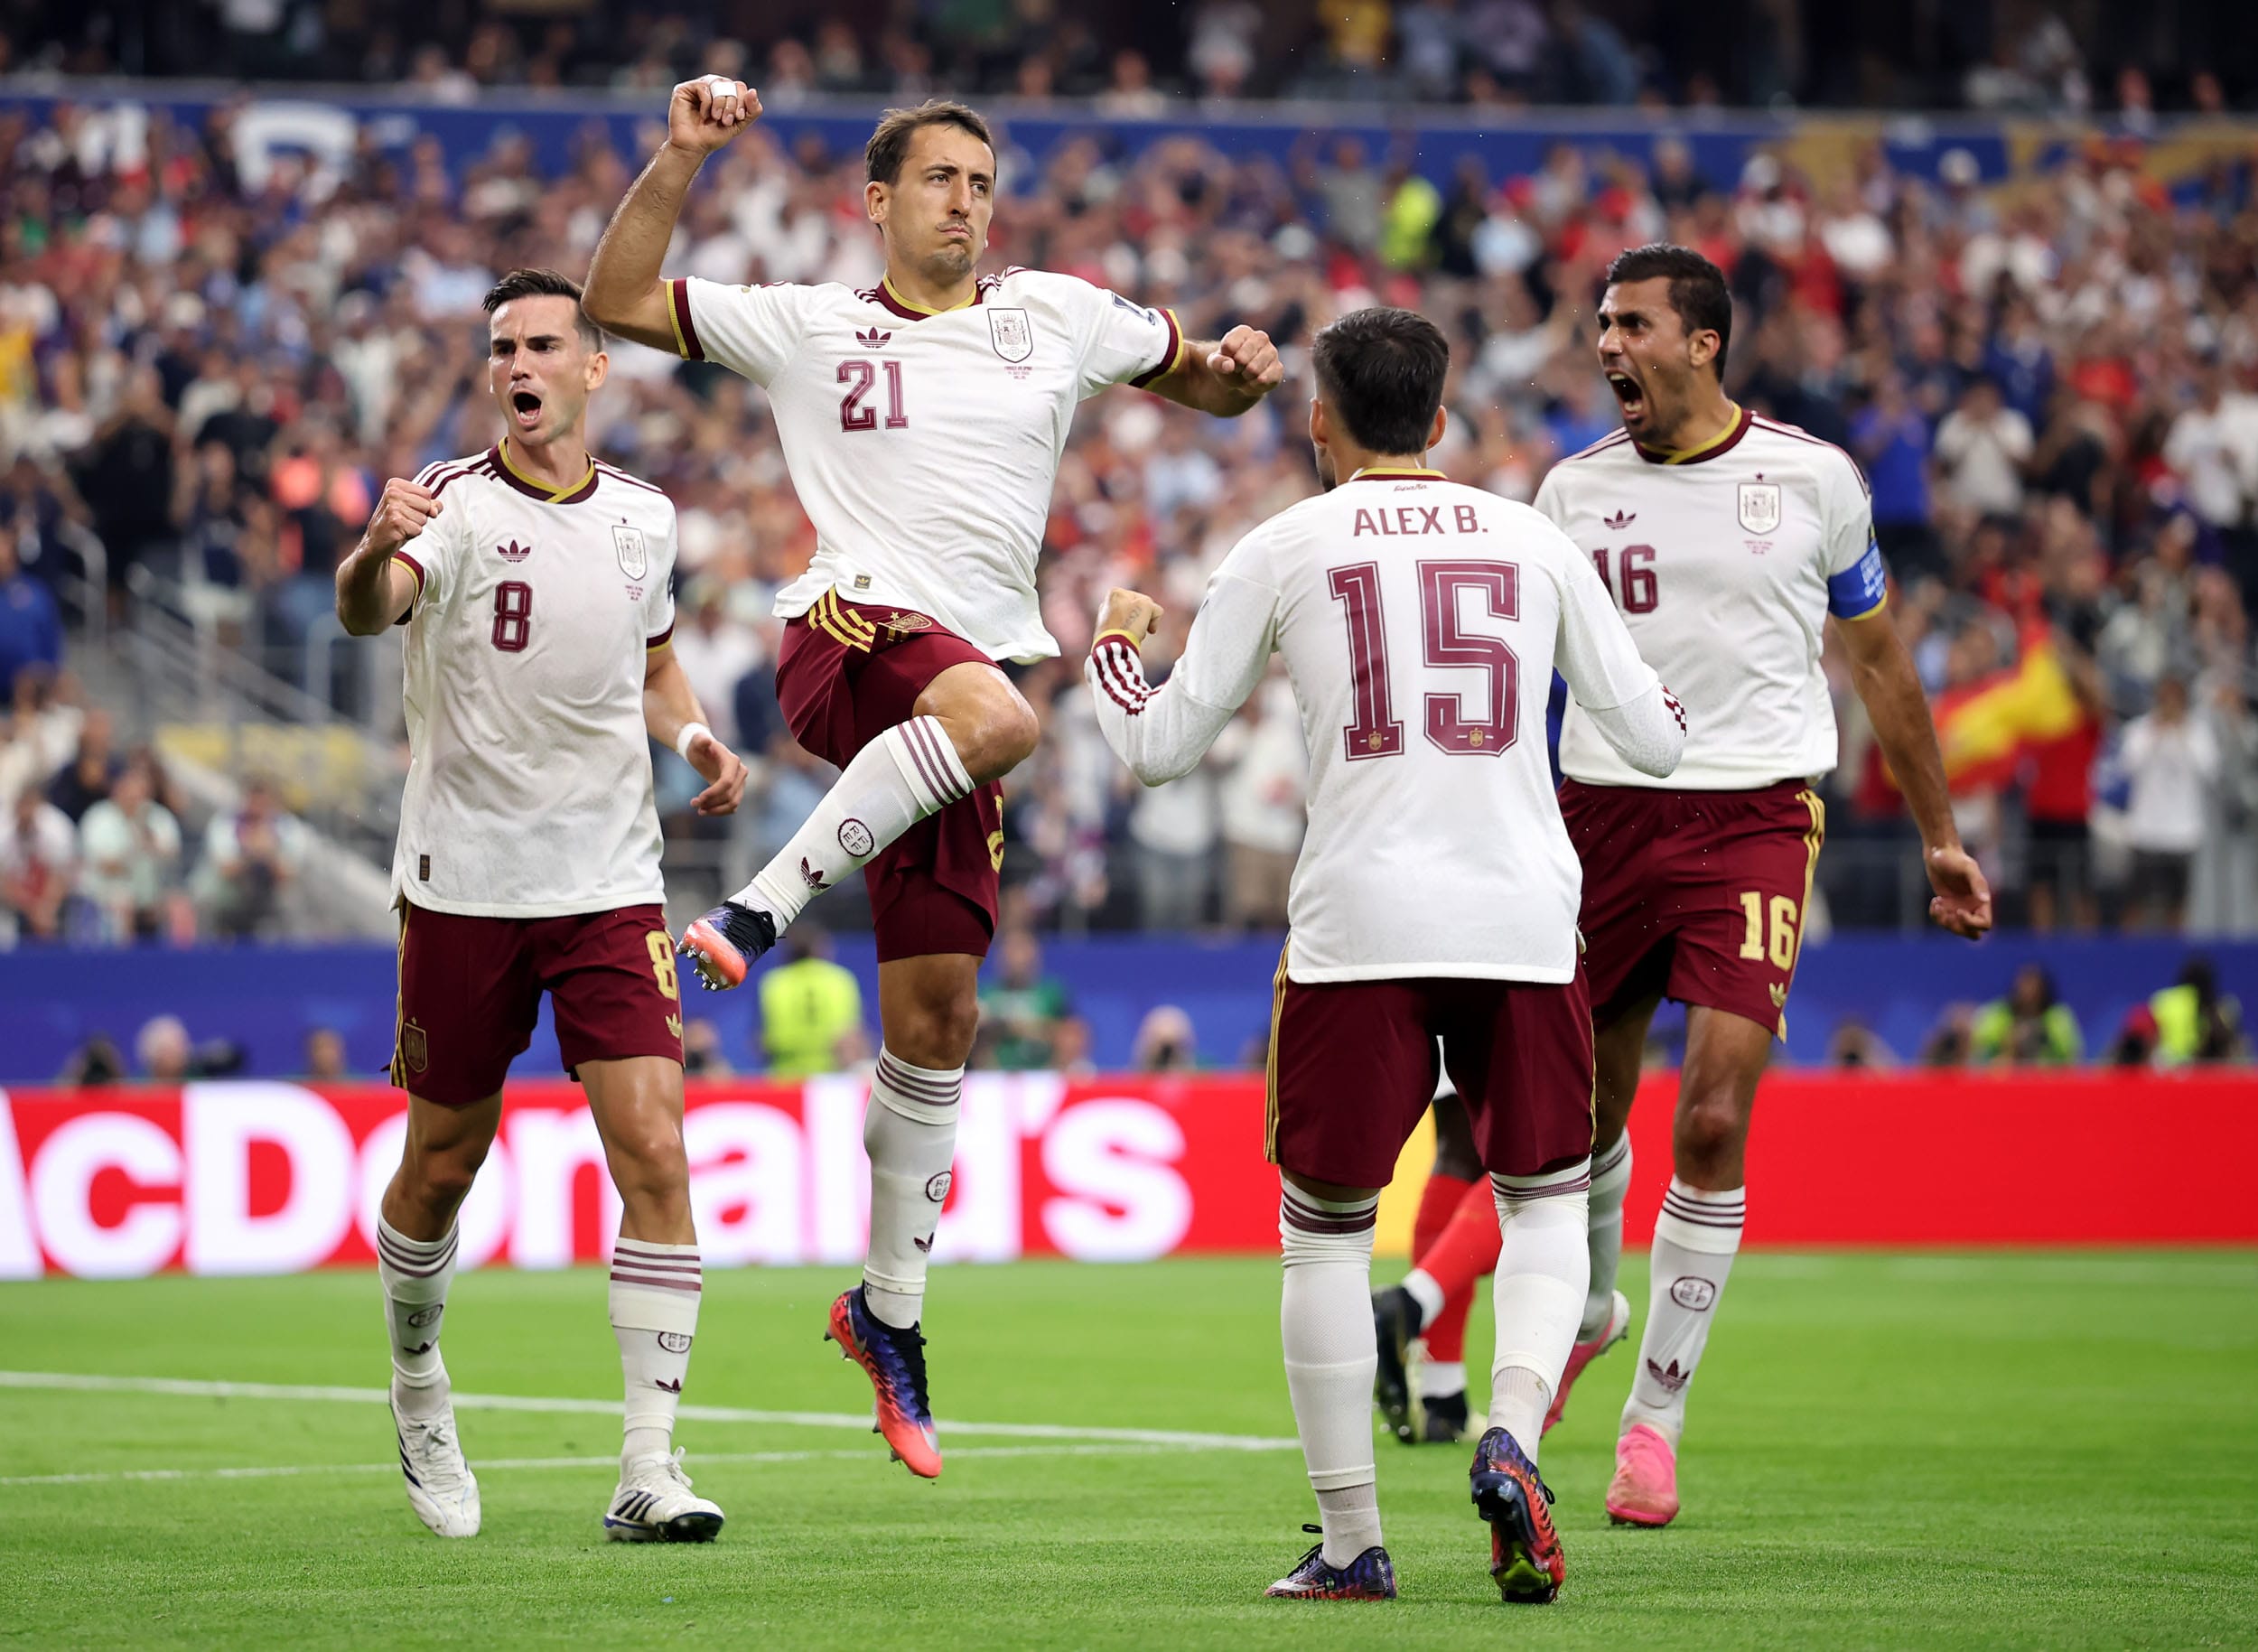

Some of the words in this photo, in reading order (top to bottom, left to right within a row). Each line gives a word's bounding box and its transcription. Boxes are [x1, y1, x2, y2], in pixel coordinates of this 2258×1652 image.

[836, 359, 909, 432] 21
[1354, 507, 1445, 537] ALEX
[1453, 505, 1488, 533] B.
[1592, 545, 1658, 614] 16
[491, 580, 533, 653] 8
[1327, 560, 1520, 761] 15
[645, 930, 677, 1001] 8
[1739, 891, 1797, 972] 16
[0, 1070, 1193, 1280] cDonald's
